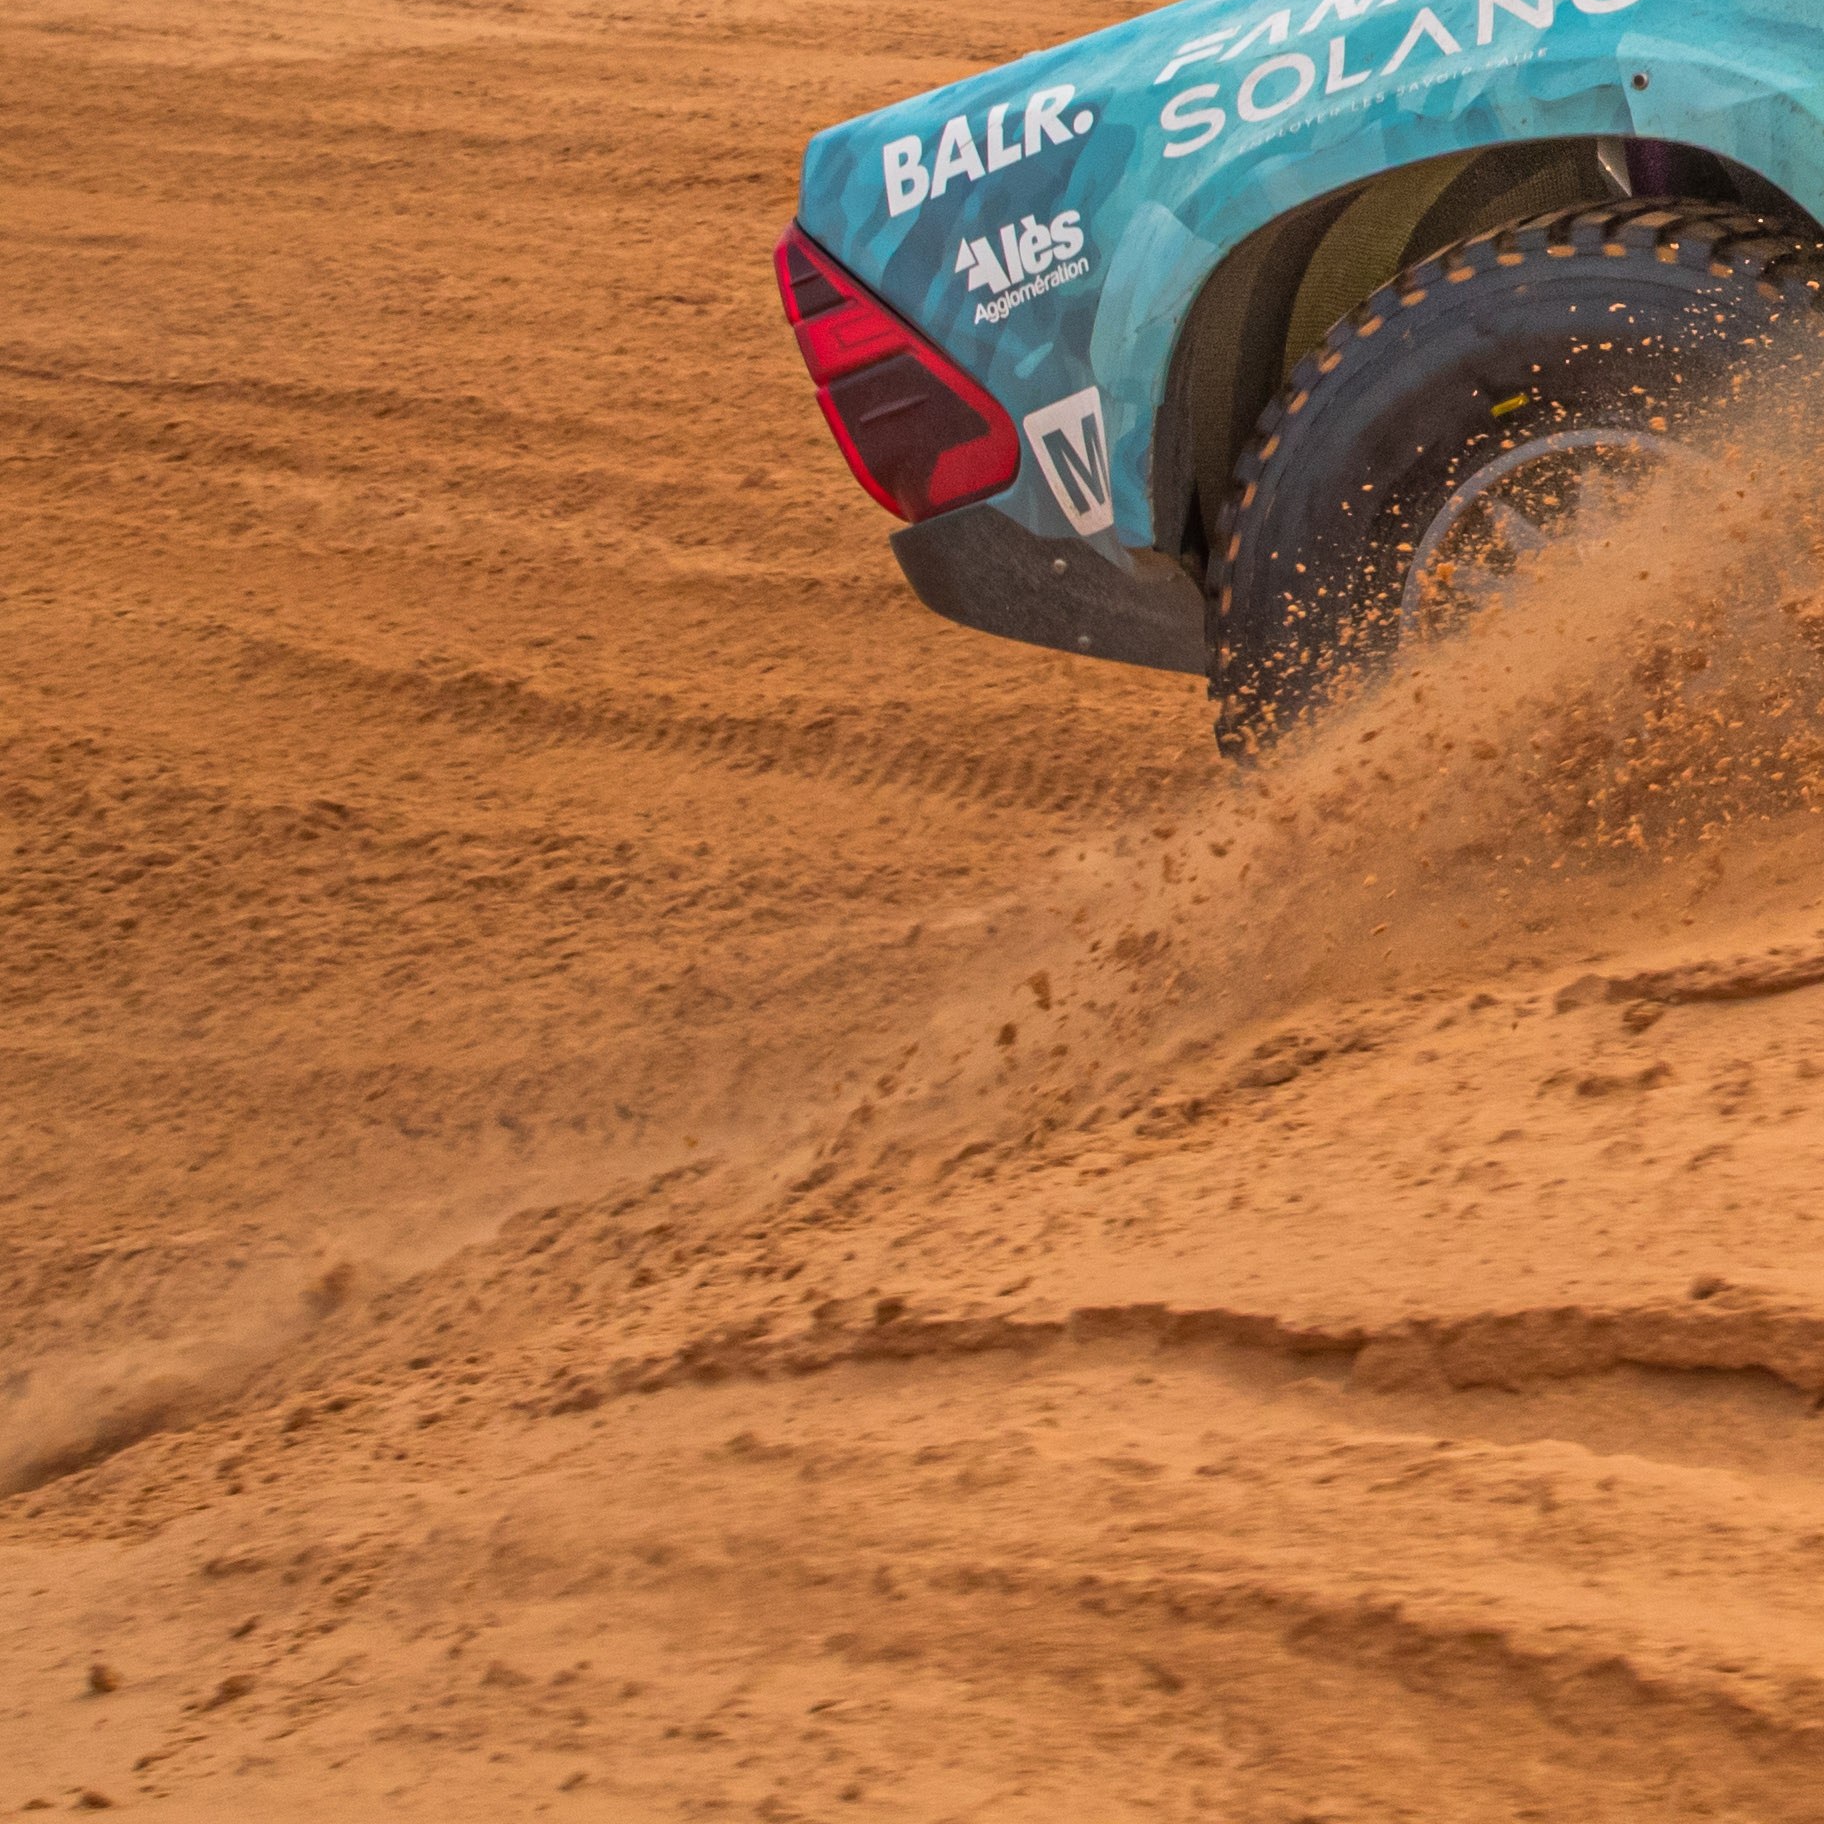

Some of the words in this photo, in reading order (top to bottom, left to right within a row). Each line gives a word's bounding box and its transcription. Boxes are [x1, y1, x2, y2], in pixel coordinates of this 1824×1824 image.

[881, 83, 1095, 218] BALR.
[954, 209, 1085, 294] Alès
[974, 257, 1090, 325] Agglomération
